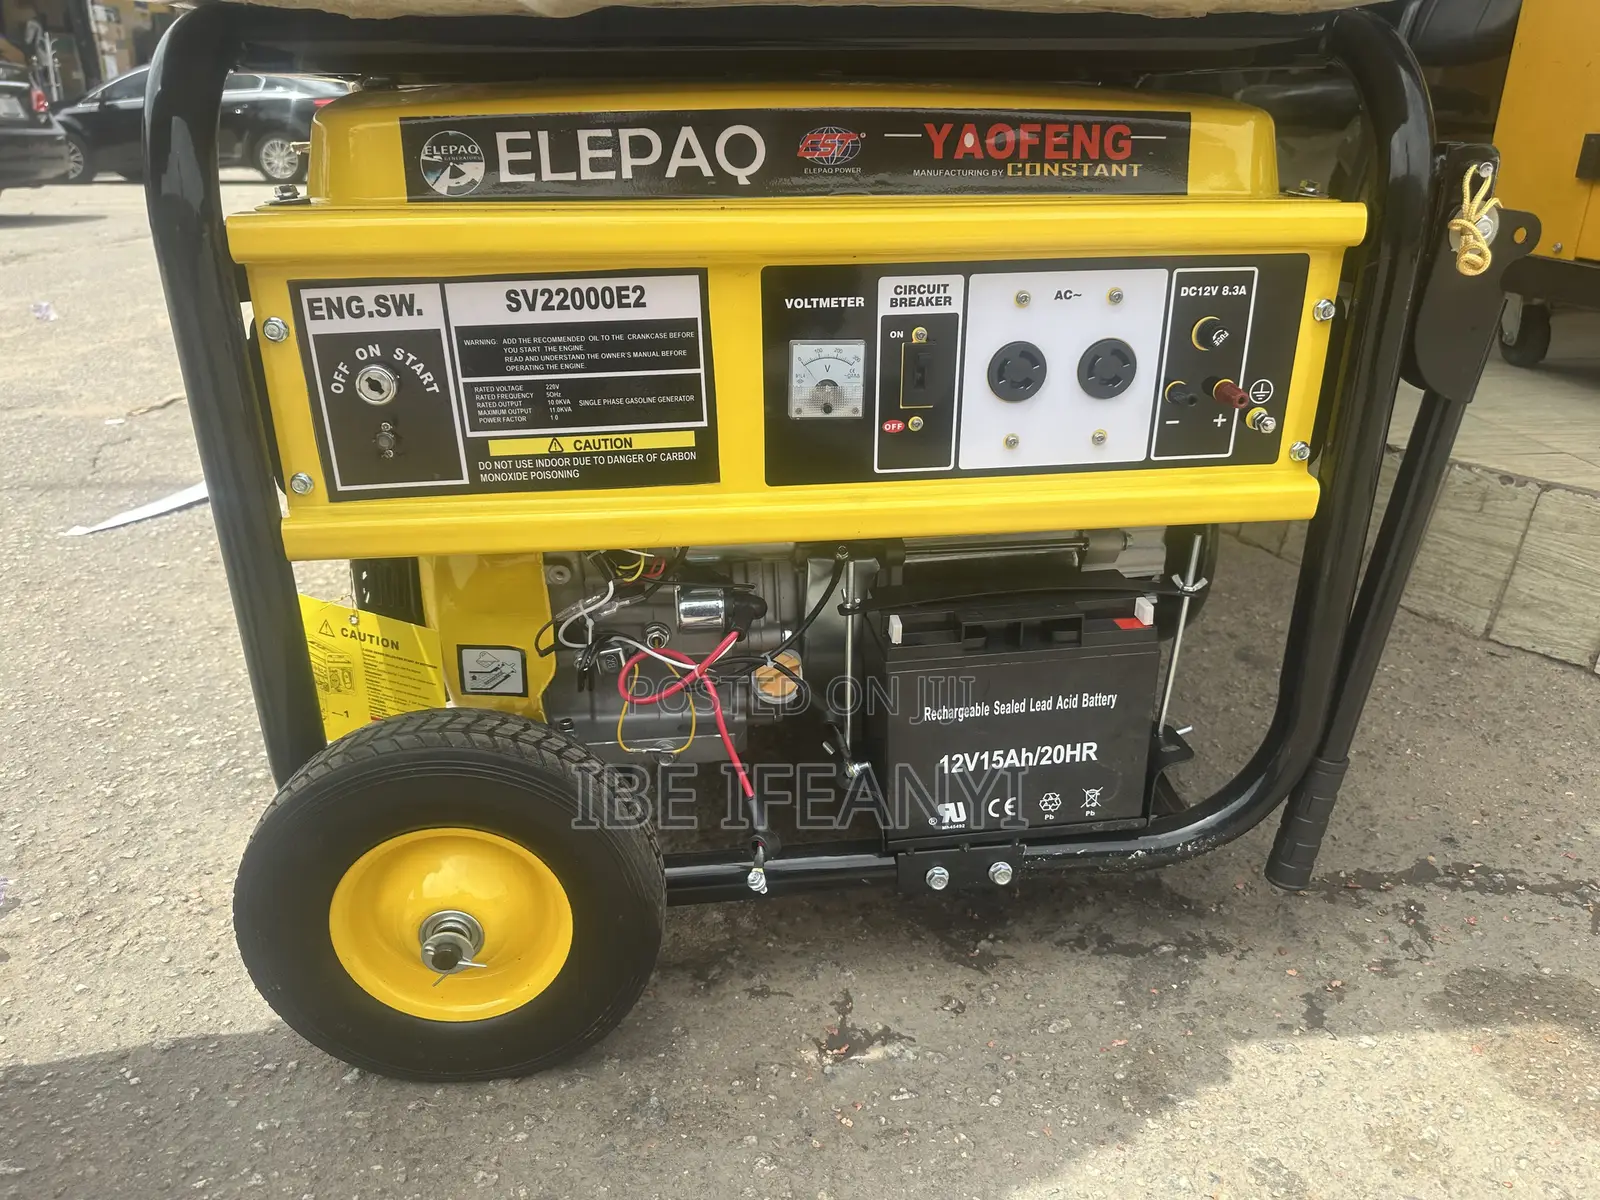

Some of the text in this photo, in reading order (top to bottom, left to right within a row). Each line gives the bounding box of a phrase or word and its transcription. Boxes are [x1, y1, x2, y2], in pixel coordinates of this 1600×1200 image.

[924, 123, 1132, 161] YAOFENG
[424, 144, 480, 156] ELEPAQ
[496, 125, 766, 185] ELEPAQ
[804, 167, 833, 175] ELEPAQ
[913, 162, 1143, 177] MANUFACTURING BY CONSTANT
[893, 284, 949, 295] CIRCUIT
[1180, 285, 1247, 297] DC12V 8.3A
[505, 285, 647, 313] SV22000E2
[785, 297, 865, 309] VOLTMETER
[889, 296, 952, 308] BREAKER
[306, 293, 424, 321] ENG.SW.
[502, 337, 517, 345] ADD
[533, 335, 586, 344] RECOMMENDED
[588, 334, 600, 342] OIL
[601, 334, 610, 342] TO
[611, 333, 625, 341] THE
[627, 332, 668, 341] CRANKCASE
[669, 331, 695, 339] BEFORE
[1213, 330, 1230, 347] FUSE
[355, 344, 381, 361] ON
[503, 346, 518, 354] YOU
[544, 345, 557, 353] THE
[504, 355, 523, 363] READ
[540, 353, 586, 362] UNDERSTAND
[600, 351, 632, 359] OWNER'S
[632, 350, 660, 358] MANUAL
[661, 349, 687, 357] BEFORE
[393, 347, 440, 394] START
[505, 364, 545, 372] OPERATING
[545, 363, 559, 371] THE
[824, 364, 831, 373] V
[331, 361, 350, 394] OFF
[496, 392, 534, 400] FREQUENCY
[578, 399, 602, 407] SINGLE
[625, 396, 656, 405] GASOLINE
[657, 394, 695, 403] GENERATOR
[476, 400, 523, 409] RATED OUTPUT
[884, 423, 903, 431] OFF
[573, 437, 633, 451] CAUTION
[478, 451, 697, 470] DO NOT USE INDOOR DUE TO DANGER OF CARBON
[480, 469, 580, 483] MONOXIDE POISONING
[340, 627, 400, 650] CAUTION
[344, 710, 349, 718] 1
[924, 692, 1117, 722] Rechargeable Sealed Lead Acid Battery
[939, 742, 1098, 774] 12V15Ah/20HR
[988, 797, 1016, 818] CE
